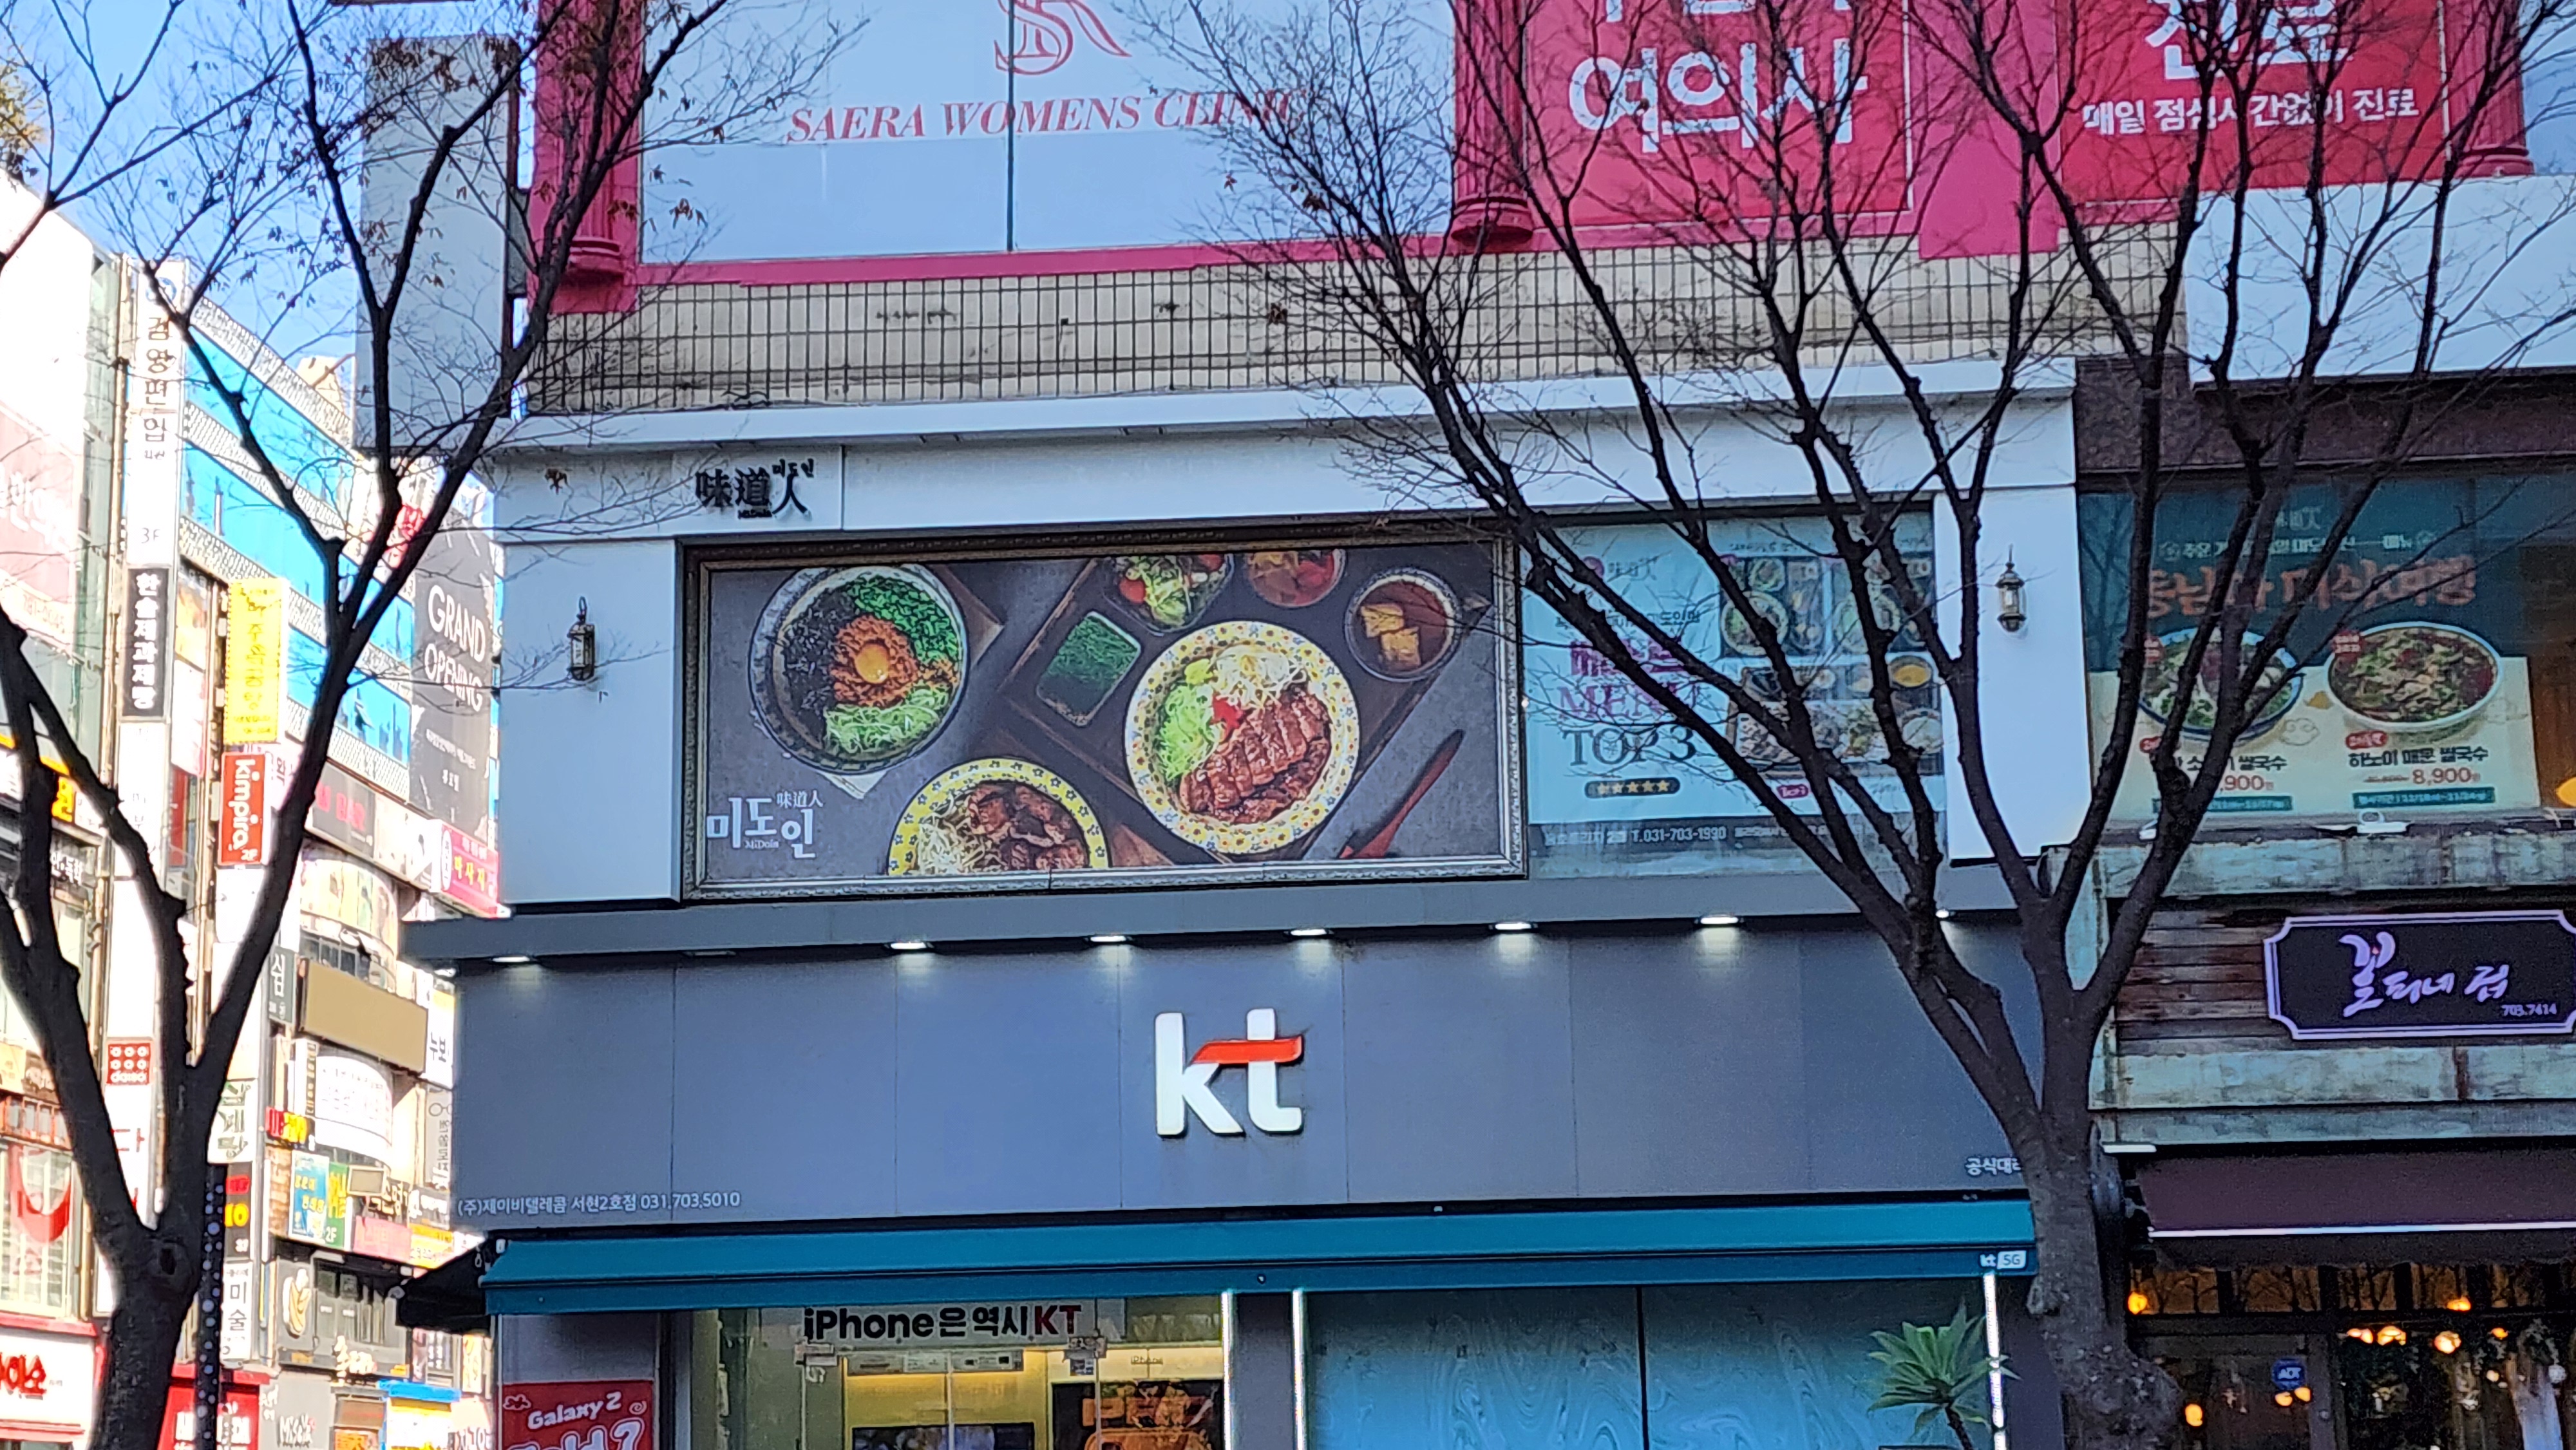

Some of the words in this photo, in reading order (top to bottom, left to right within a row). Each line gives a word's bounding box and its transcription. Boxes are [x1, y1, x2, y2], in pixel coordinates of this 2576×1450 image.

[1569, 39, 1867, 153] 여의사
[2083, 99, 2145, 135] 매일
[2353, 88, 2419, 121] 진료
[787, 104, 925, 144] SAERA
[941, 97, 1141, 136] WOMENS
[772, 458, 814, 478] 미도인
[428, 585, 486, 663] GRAND
[424, 643, 483, 711] OPENING
[2439, 745, 2489, 763] 쌀국수
[228, 759, 260, 851] kimpira
[777, 789, 824, 809] 味道人
[706, 796, 816, 858] 미도인
[2501, 1003, 2558, 1017] 703.7414
[1155, 1008, 1302, 1135] kt
[571, 1192, 637, 1212] 서현2호점
[639, 1191, 741, 1211] 031.703.5010
[2002, 1254, 2021, 1266] 5G
[227, 1281, 248, 1332] 미술
[0, 1353, 47, 1395] 이소
[527, 1400, 604, 1430] Galaxy
